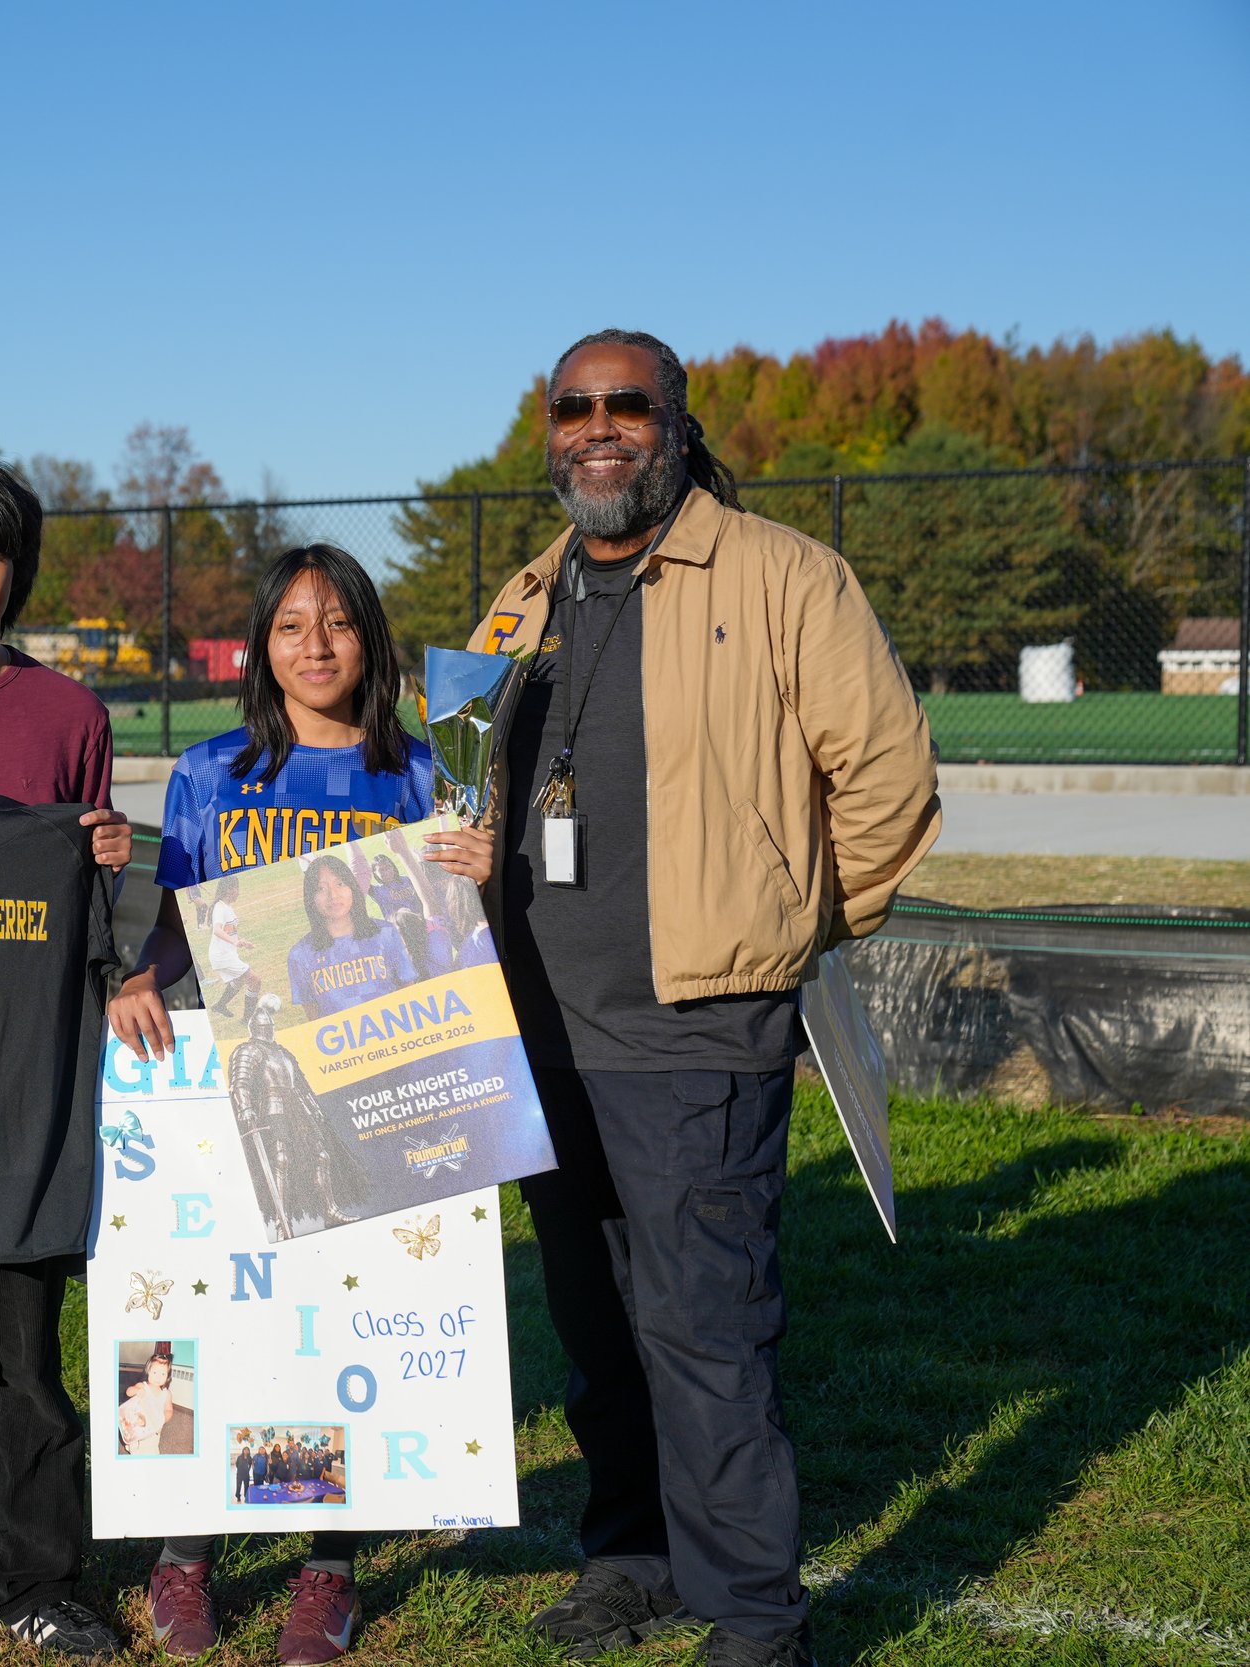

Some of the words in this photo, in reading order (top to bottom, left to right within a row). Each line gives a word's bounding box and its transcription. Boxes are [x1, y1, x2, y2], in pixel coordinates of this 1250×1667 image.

[218, 807, 401, 872] KNIGHT
[310, 955, 388, 995] KNIGHTS
[315, 989, 472, 1056] GIANNA
[319, 1054, 365, 1075] VARSITY
[367, 1045, 398, 1062] GIRLS
[400, 1032, 444, 1053] SOCCER
[445, 1023, 475, 1040] 2026
[347, 1089, 395, 1113] YOUR
[397, 1068, 469, 1098] KNIGHTS
[351, 1103, 413, 1130] WATCH
[415, 1092, 449, 1113] HAS
[452, 1076, 505, 1102] ENDED
[358, 1130, 373, 1141] BUT
[374, 1124, 397, 1137] ONCE
[398, 1122, 405, 1130] A
[404, 1115, 438, 1129] KNIGHT,
[438, 1103, 472, 1118] ALWAYS
[473, 1101, 480, 1109] A
[480, 1091, 514, 1106] KNIGHT.
[405, 1136, 469, 1165] FOUNDATION
[352, 1310, 425, 1339] Class
[400, 1348, 466, 1380] 2027
